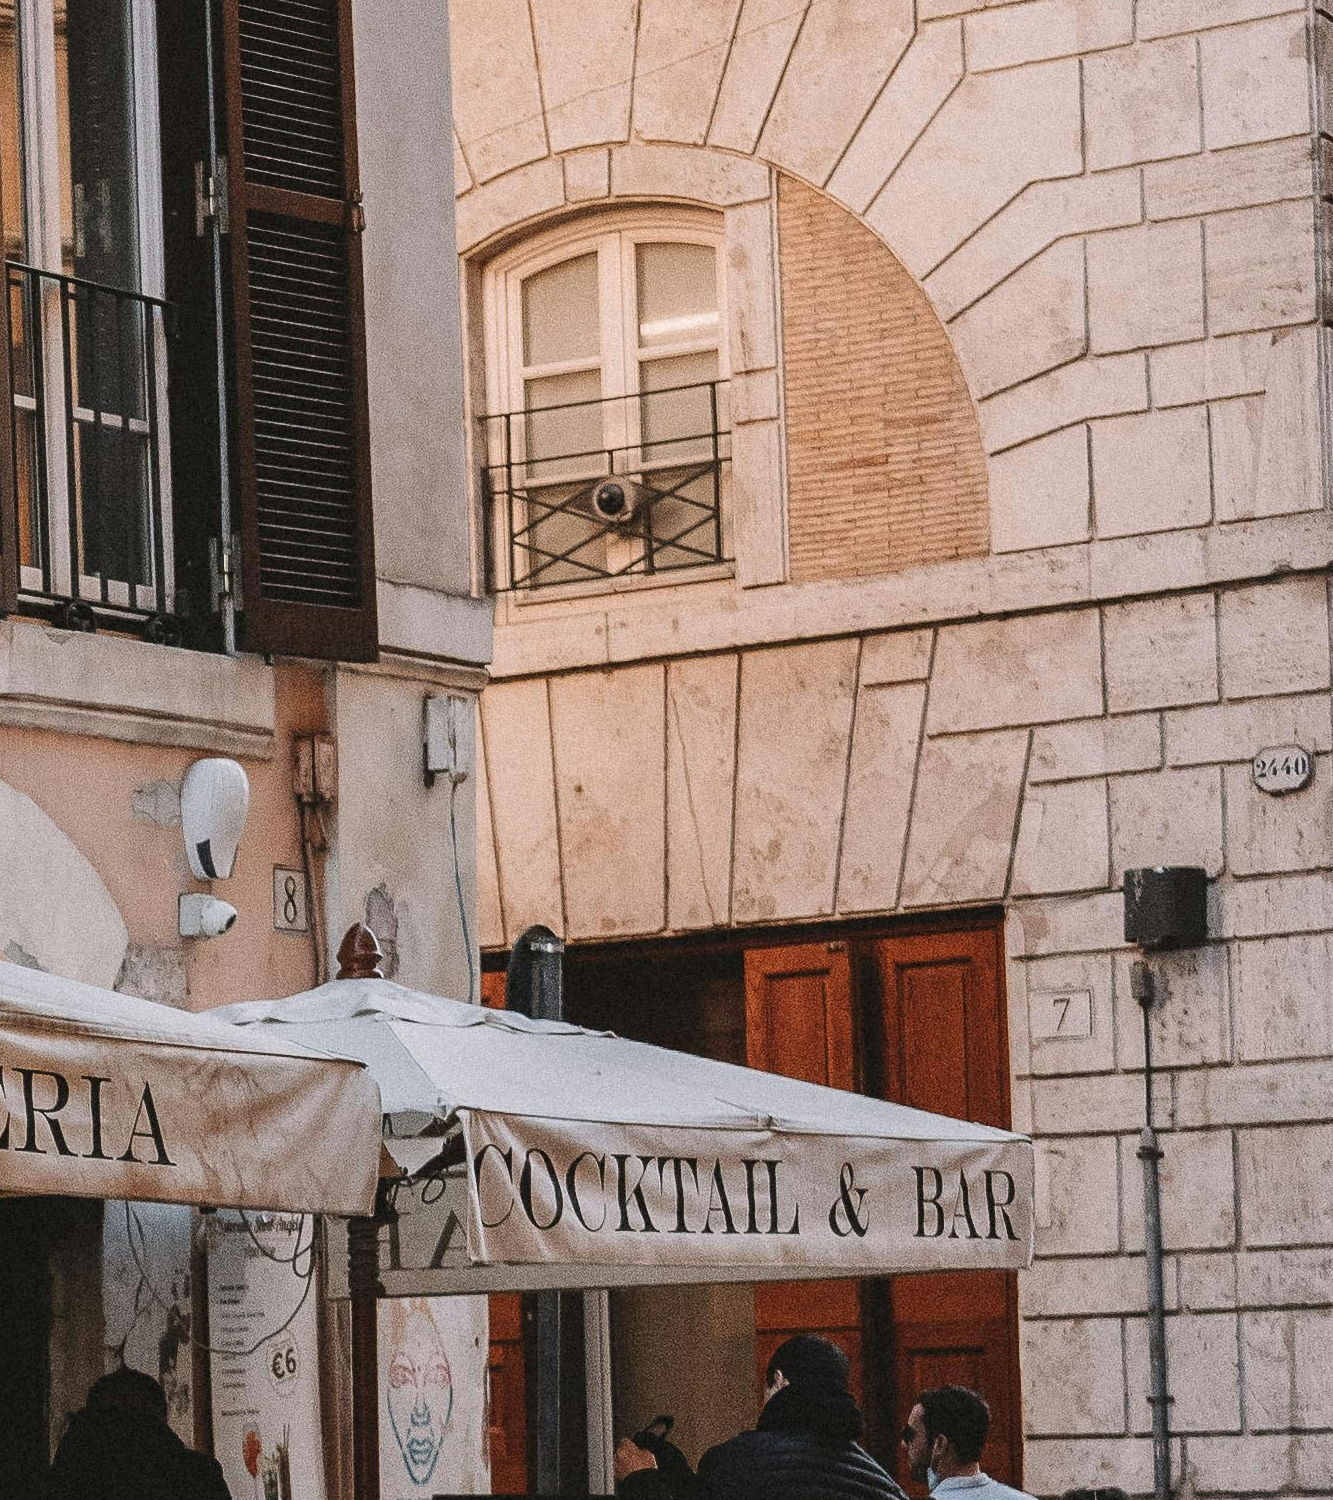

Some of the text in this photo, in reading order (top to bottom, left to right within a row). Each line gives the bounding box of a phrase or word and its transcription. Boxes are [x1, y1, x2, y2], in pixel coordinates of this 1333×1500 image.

[1253, 755, 1307, 778] 2440
[283, 875, 297, 924] 8
[1052, 997, 1071, 1032] 7
[473, 1143, 1021, 1242] COCKTAIL & BAR
[271, 1345, 297, 1379] €6
